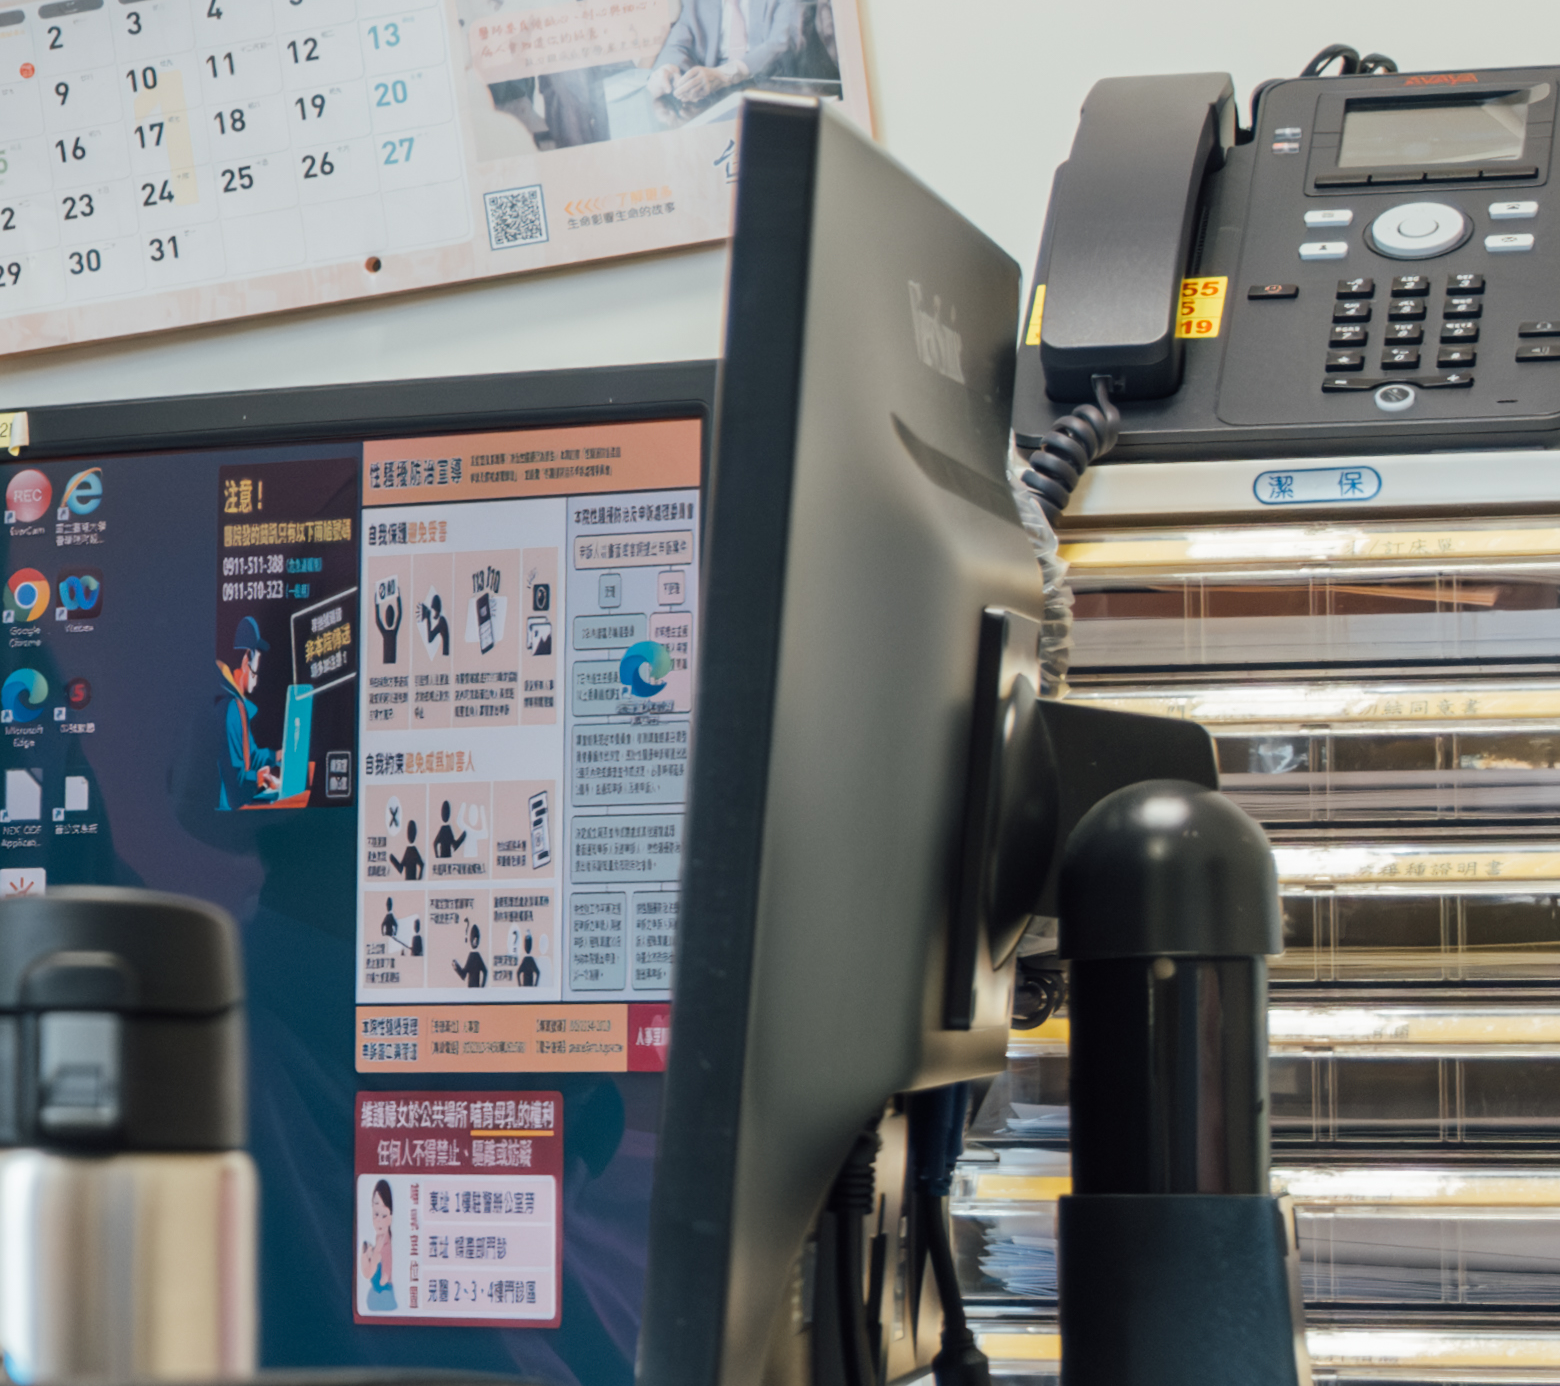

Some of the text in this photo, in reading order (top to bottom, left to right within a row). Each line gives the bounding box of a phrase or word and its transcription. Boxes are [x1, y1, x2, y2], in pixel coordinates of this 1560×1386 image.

[47, 26, 64, 50] 2
[126, 12, 142, 35] 3
[1404, 73, 1479, 86] AVAYA
[55, 137, 87, 163] 16
[134, 122, 165, 149] 17
[214, 109, 246, 135] 18
[294, 94, 326, 121] 19
[374, 80, 408, 107] 20
[69, 249, 102, 275] 30
[149, 236, 180, 262] 31
[13, 488, 43, 504] REC
[222, 580, 284, 601] 0911-510-323
